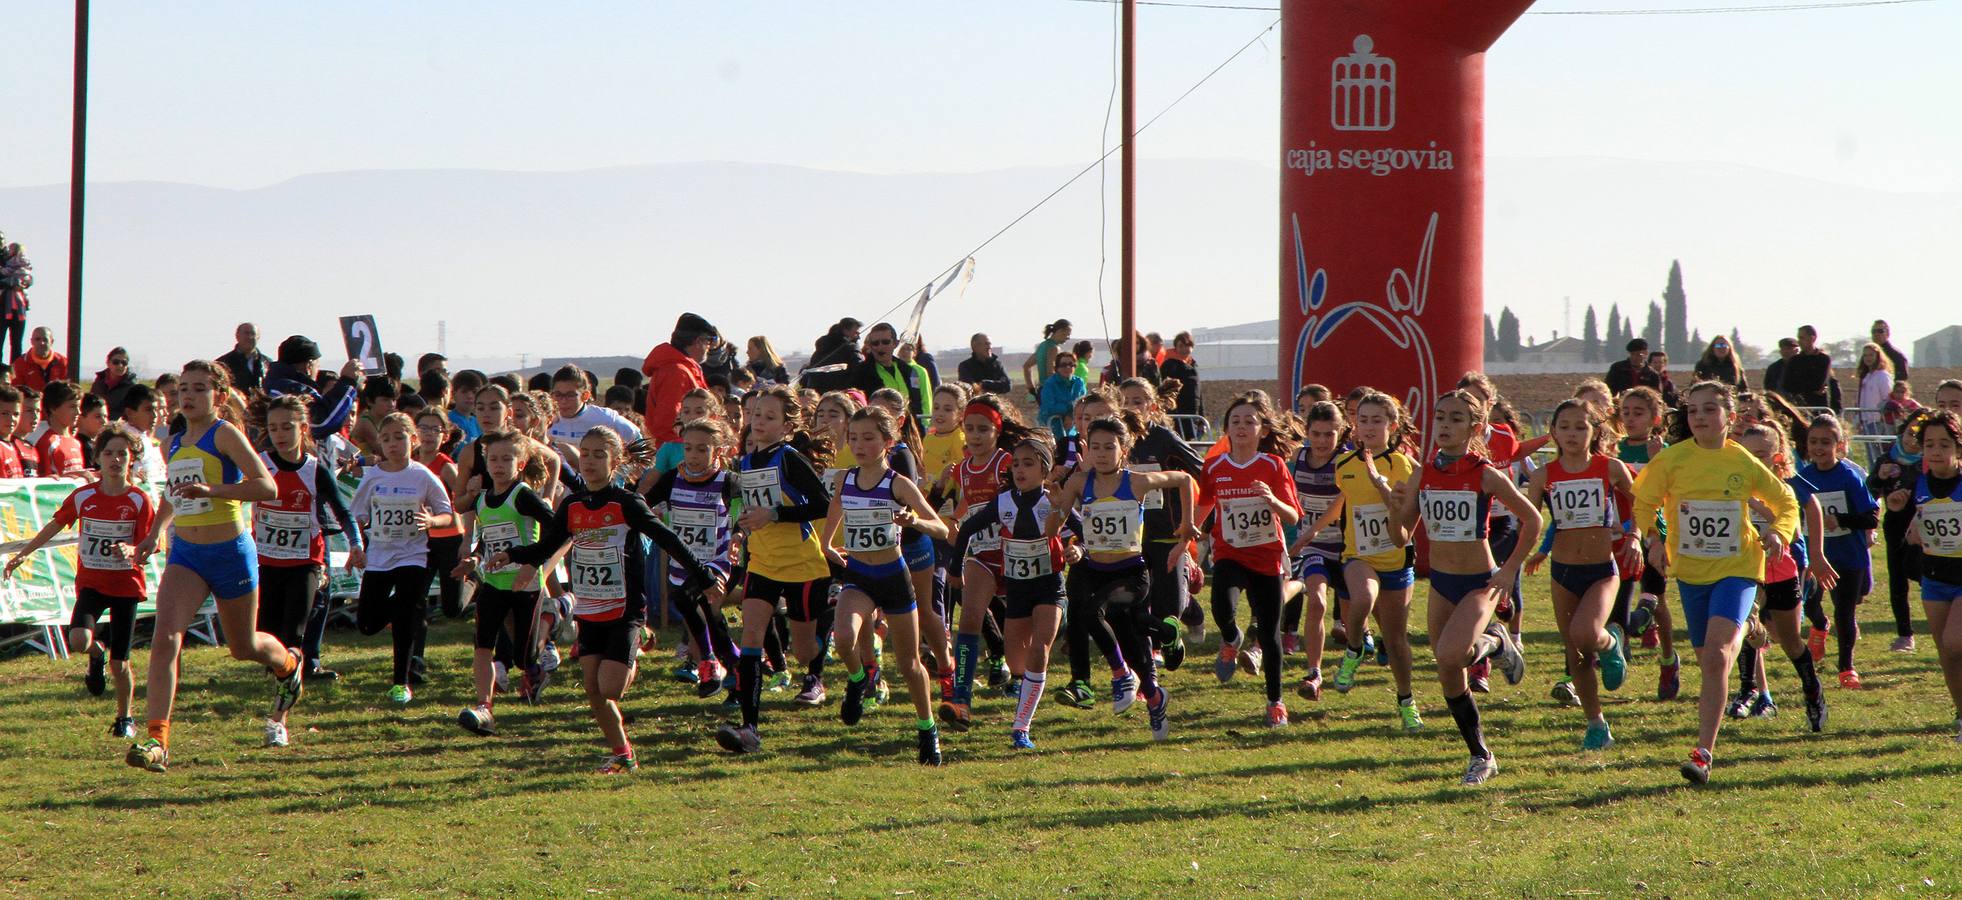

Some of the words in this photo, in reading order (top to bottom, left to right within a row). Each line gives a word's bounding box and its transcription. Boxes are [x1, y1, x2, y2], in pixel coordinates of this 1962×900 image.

[1287, 140, 1333, 176] caja
[1338, 140, 1454, 176] segovia
[351, 320, 378, 369] 2
[1553, 488, 1600, 510] 1021
[375, 509, 414, 526] 1238
[1227, 508, 1272, 530] 1349
[1424, 500, 1470, 521] 1080
[1091, 515, 1128, 535] 951
[1689, 516, 1730, 538] 962
[1923, 517, 1961, 537] 963
[88, 536, 126, 557] 78
[264, 526, 302, 548] 787
[847, 526, 888, 549] 756
[576, 564, 614, 586] 732
[1008, 558, 1041, 577] 731
